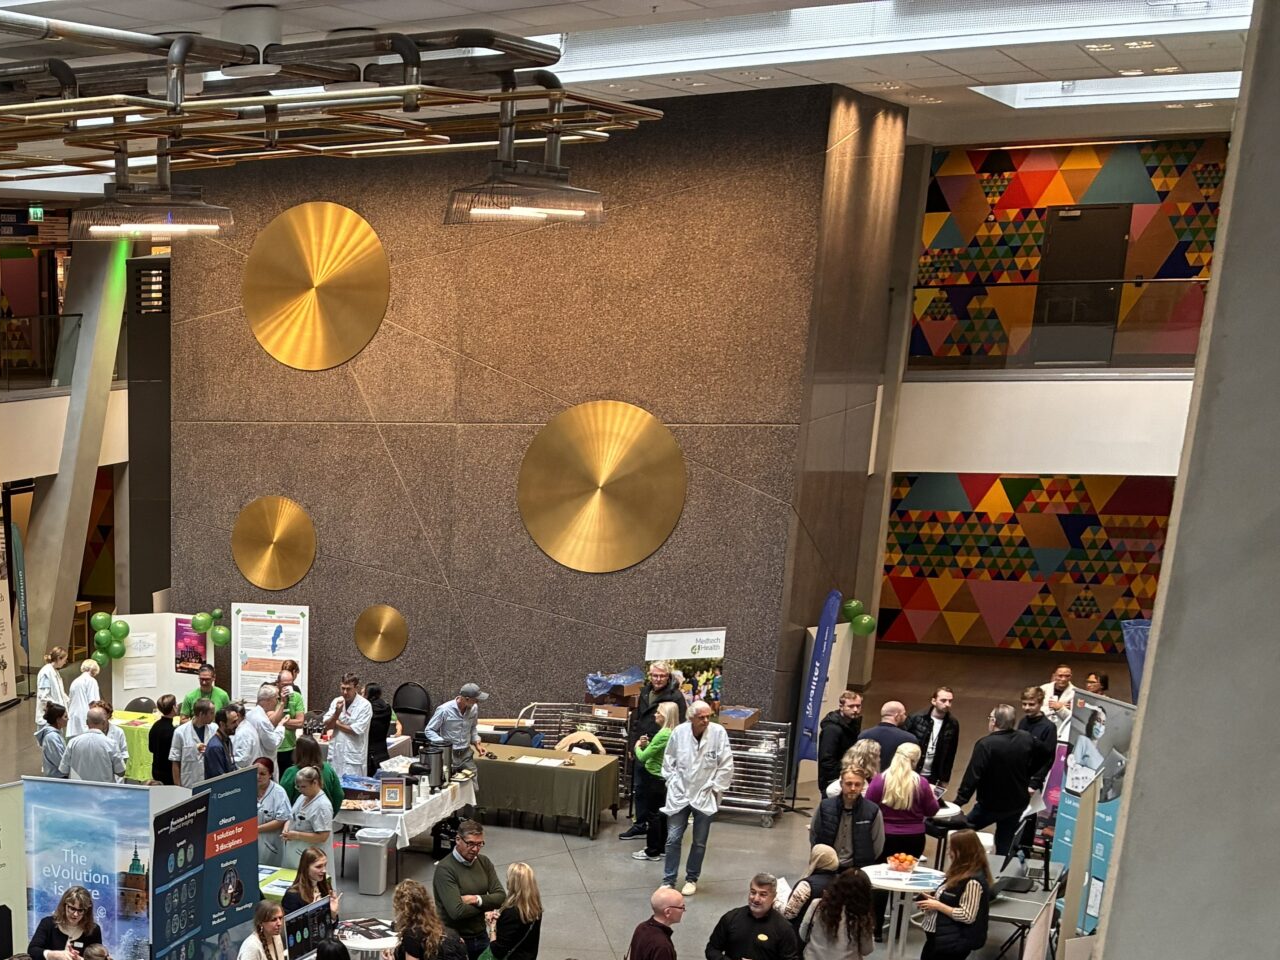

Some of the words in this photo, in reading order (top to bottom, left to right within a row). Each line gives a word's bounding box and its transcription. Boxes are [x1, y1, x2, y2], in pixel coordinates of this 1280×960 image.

[219, 816, 236, 826] cNeuro
[216, 829, 235, 839] solution
[215, 844, 220, 852] 3
[62, 849, 87, 866] The
[42, 864, 109, 885] eVolution
[54, 881, 64, 896] is
